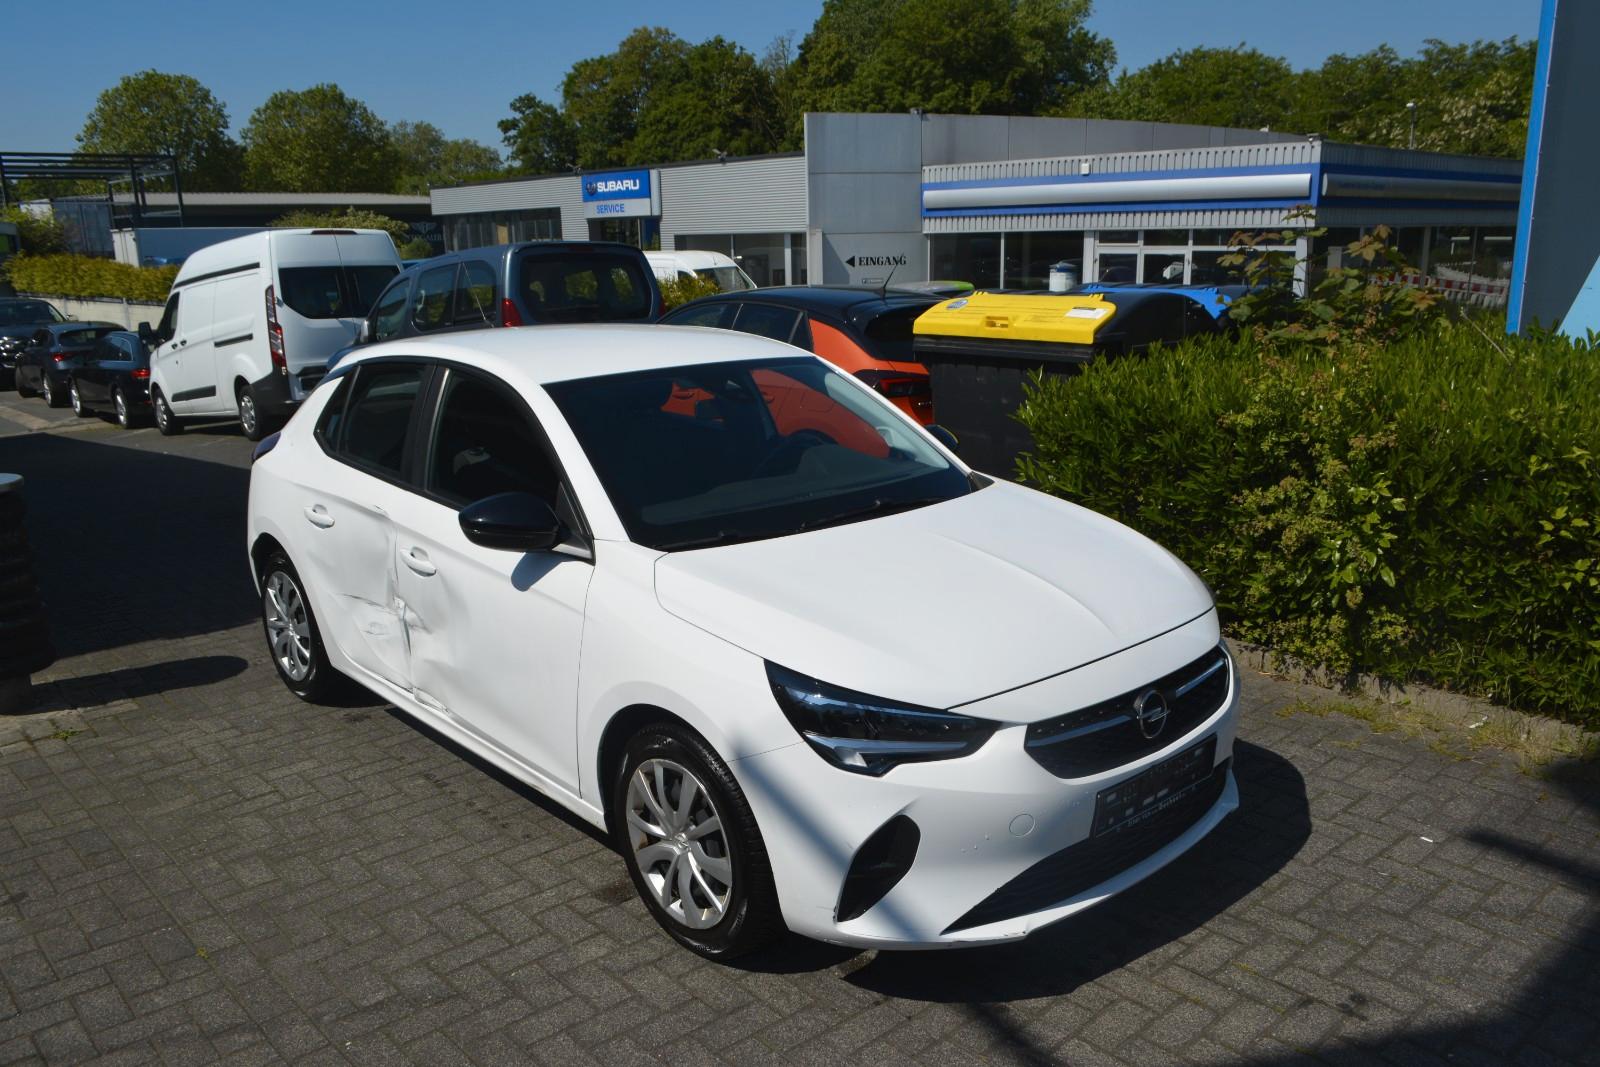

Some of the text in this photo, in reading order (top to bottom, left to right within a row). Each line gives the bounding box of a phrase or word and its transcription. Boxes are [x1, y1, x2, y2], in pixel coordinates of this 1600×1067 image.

[597, 179, 640, 192] SUBARU
[596, 203, 625, 214] SERVICE
[858, 255, 907, 266] EINGANG
